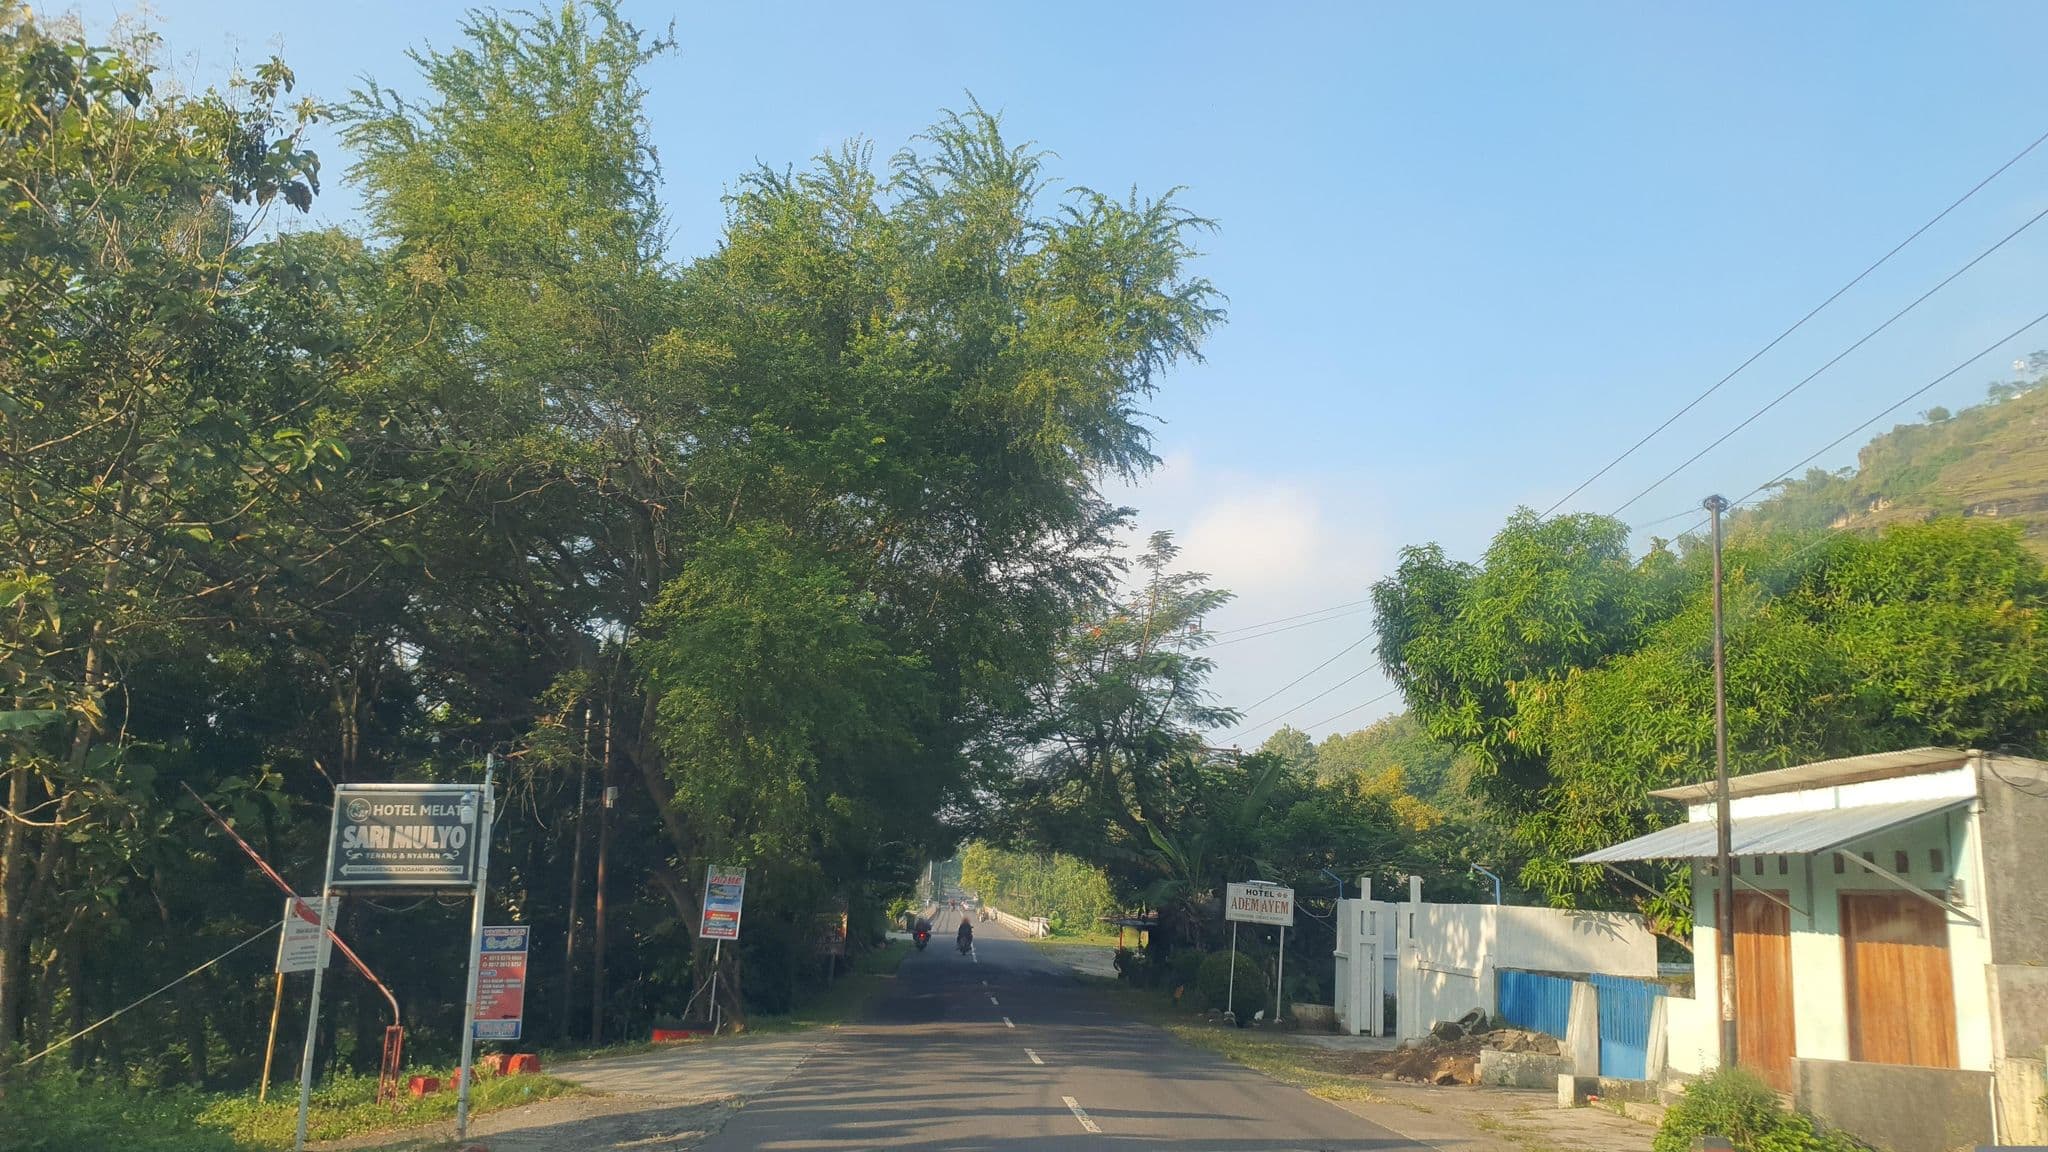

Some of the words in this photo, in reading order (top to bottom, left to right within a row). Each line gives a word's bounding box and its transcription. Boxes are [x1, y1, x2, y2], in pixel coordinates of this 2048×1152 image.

[373, 805, 416, 816] HOTEL
[419, 805, 462, 816] MELAT
[342, 825, 390, 849] SARI
[393, 825, 466, 849] MULYO
[1246, 889, 1274, 897] HOTEL
[1231, 897, 1259, 912] ADEM
[1261, 899, 1289, 914] AYEM
